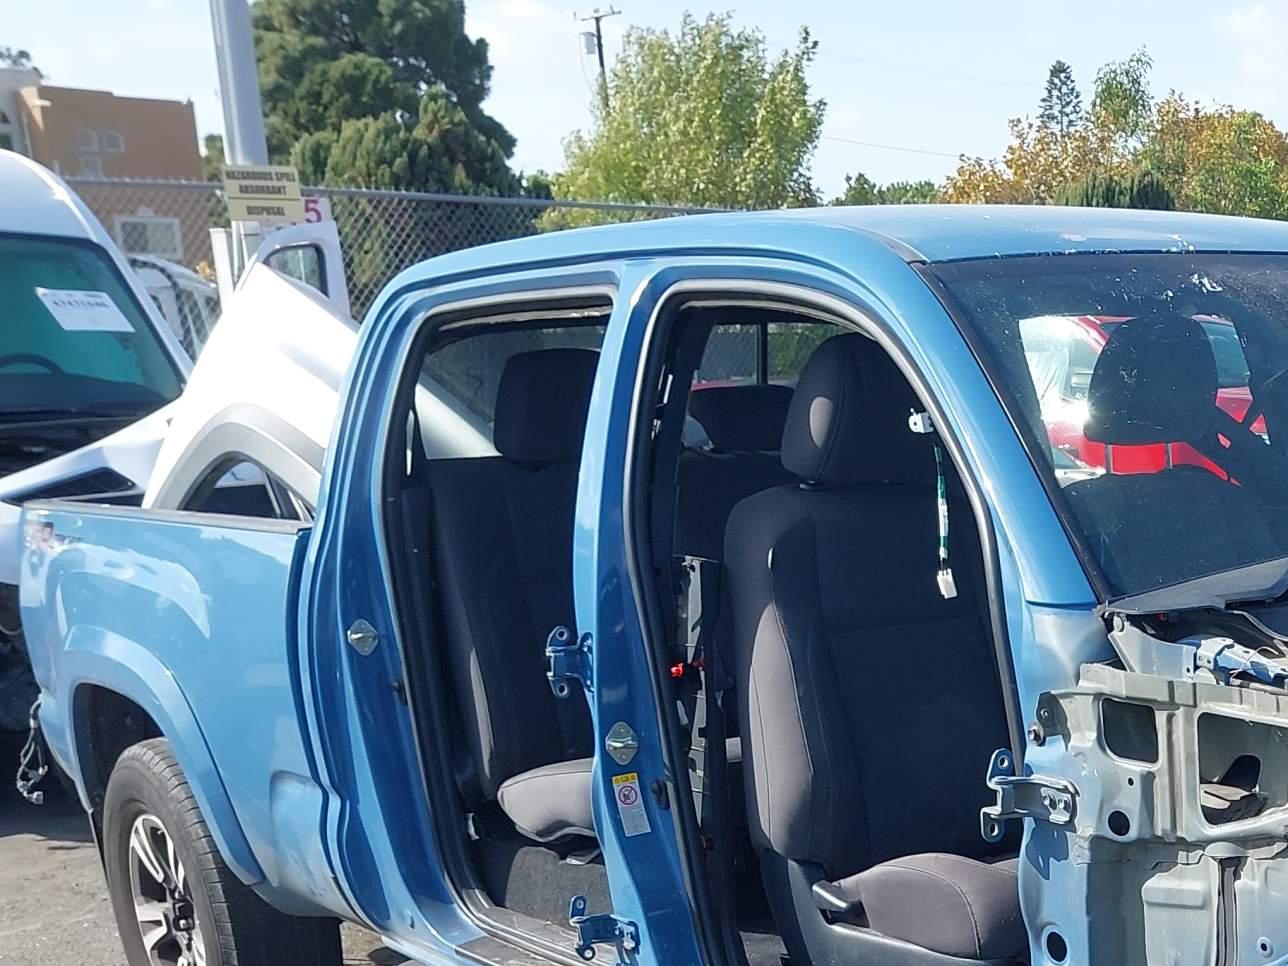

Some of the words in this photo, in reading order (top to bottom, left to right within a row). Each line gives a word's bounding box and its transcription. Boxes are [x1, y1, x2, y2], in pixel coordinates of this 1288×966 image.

[225, 170, 273, 181] HAZARDOUS
[274, 172, 297, 183] SPILL
[245, 205, 286, 217] DISPOSAL
[304, 199, 322, 224] 5
